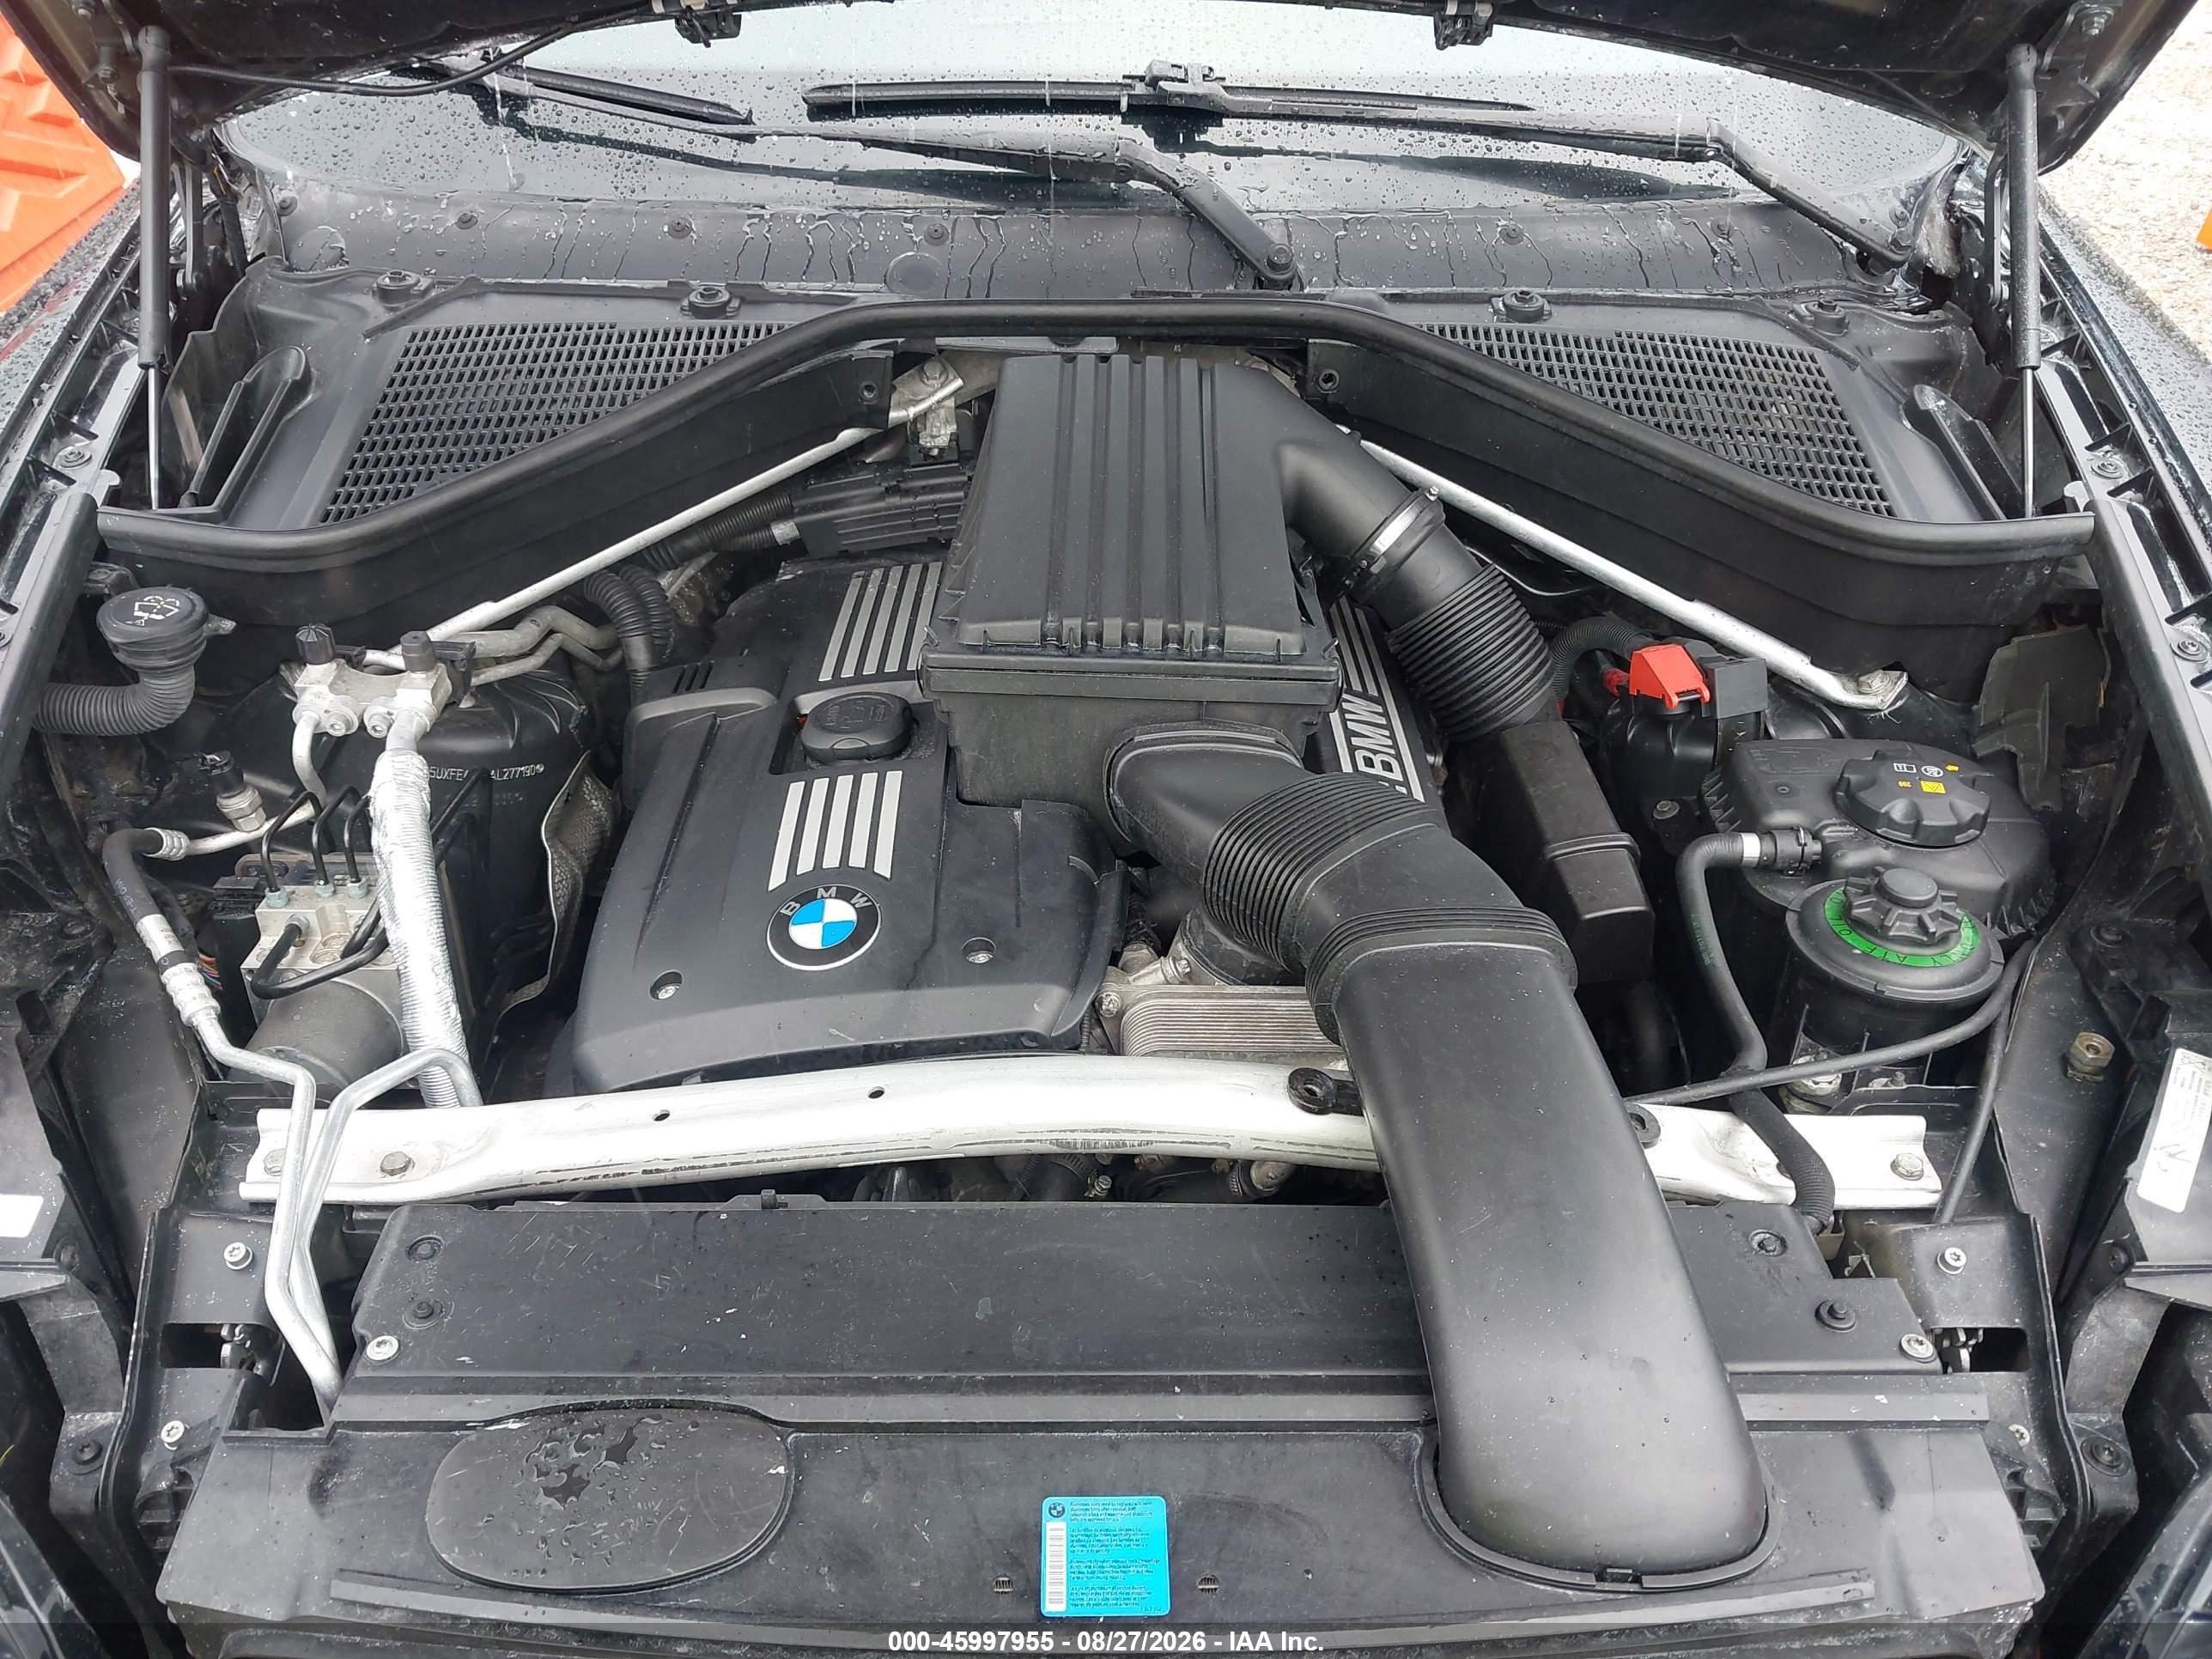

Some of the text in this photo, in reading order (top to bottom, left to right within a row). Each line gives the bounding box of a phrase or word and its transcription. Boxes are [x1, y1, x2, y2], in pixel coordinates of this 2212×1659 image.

[1341, 693, 1404, 781] BMW
[780, 886, 872, 917] BMW
[1866, 947, 1908, 963] ATF
